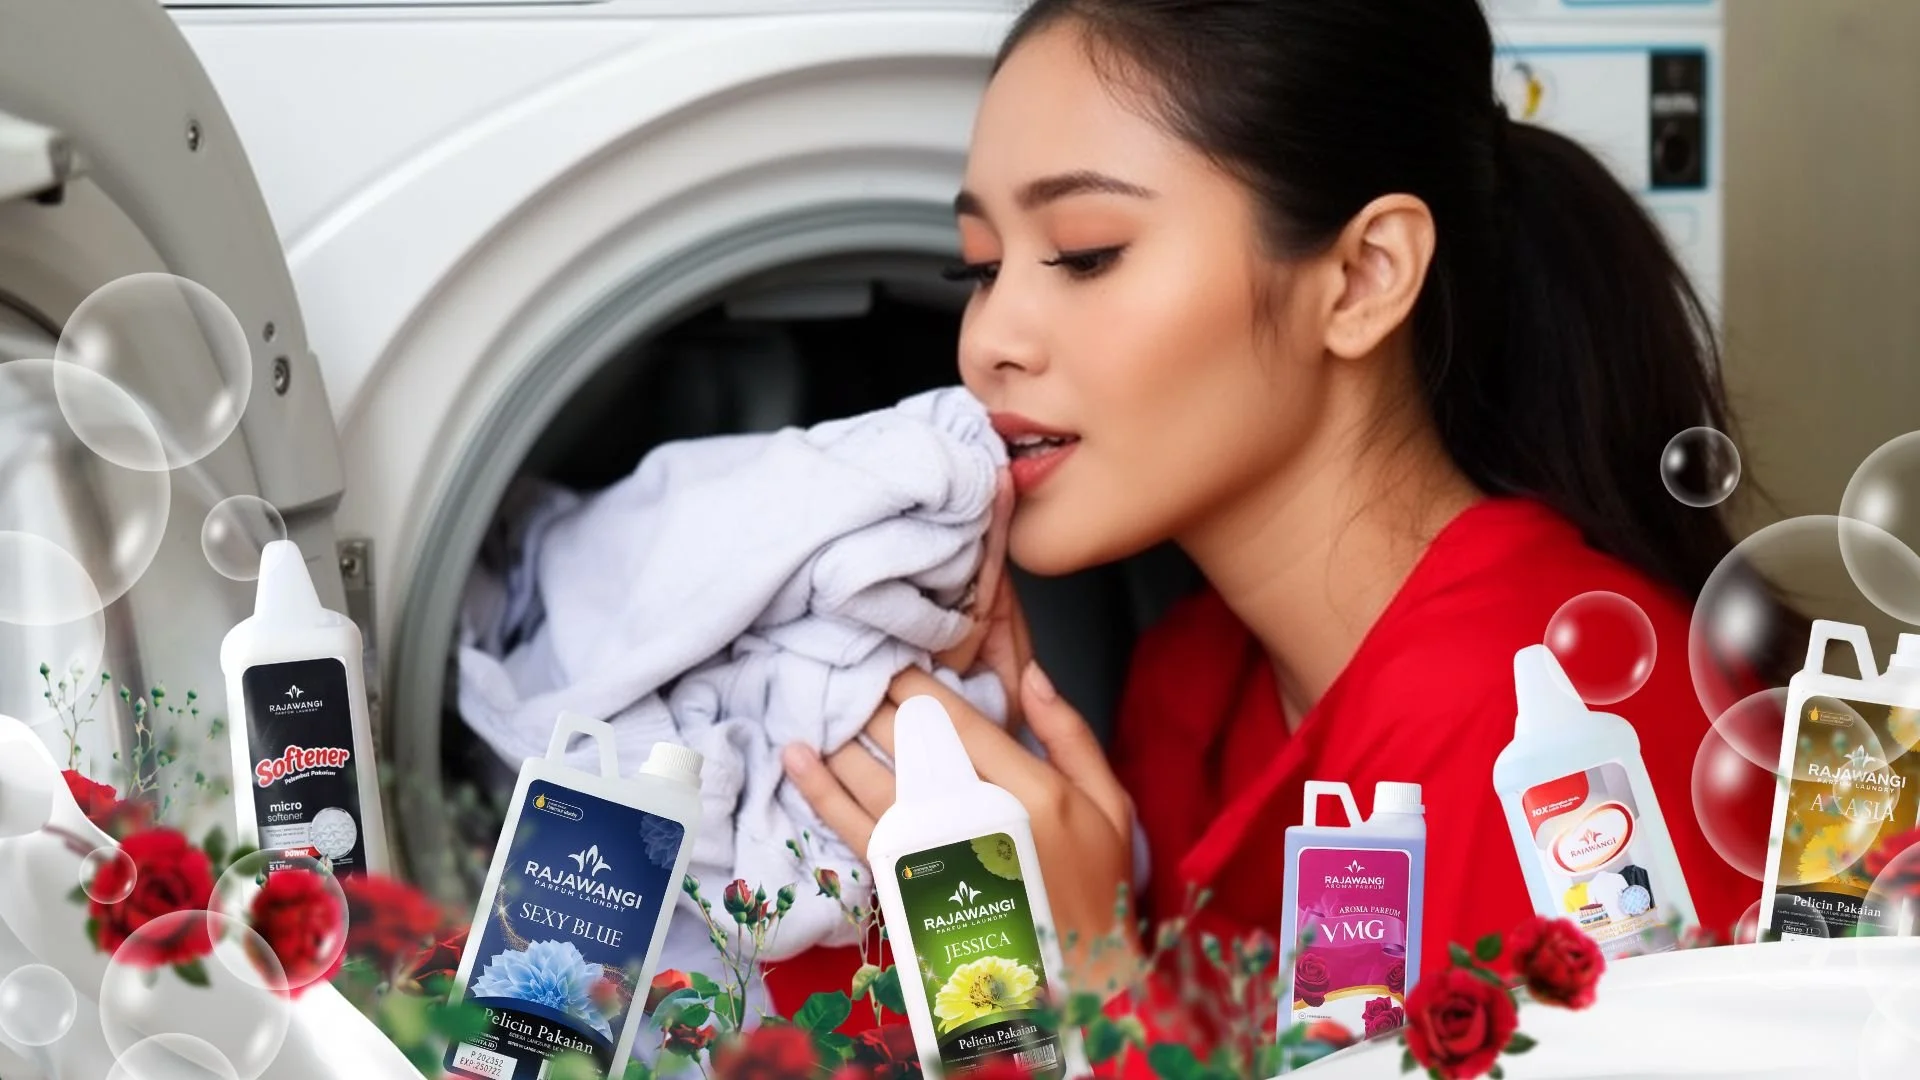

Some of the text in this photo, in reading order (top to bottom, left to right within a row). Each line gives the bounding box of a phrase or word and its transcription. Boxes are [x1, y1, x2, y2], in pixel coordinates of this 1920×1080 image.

[269, 700, 323, 712] RAJAWANGI
[255, 745, 350, 788] Softener
[1808, 763, 1906, 788] RAJAWANGI
[1855, 783, 1895, 794] LAUNDRY
[268, 812, 303, 823] softener
[270, 801, 303, 812] micro
[1532, 806, 1550, 818] 10X
[1570, 836, 1617, 858] RAJAWANGI
[270, 864, 275, 872] 5
[525, 860, 643, 910] RAJAWANGI
[1324, 876, 1384, 885] RAJAWANGI
[534, 880, 626, 912] PARFUM LAUNDRY
[1793, 895, 1833, 911] Pelicin
[1836, 902, 1881, 918] Pakaian
[924, 898, 1016, 930] RAJAWANGI
[936, 912, 1008, 934] PARFUM LAUNDRY
[1340, 906, 1401, 918] AROMA PARFUM
[520, 902, 624, 948] SEXY BLUE
[1320, 920, 1386, 944] VMG
[944, 930, 1012, 964] JESSICA
[484, 1007, 532, 1036] Pelicin
[536, 1025, 594, 1055] Pakaian
[958, 1034, 996, 1050] Pelicin
[996, 1024, 1038, 1044] Pakaian
